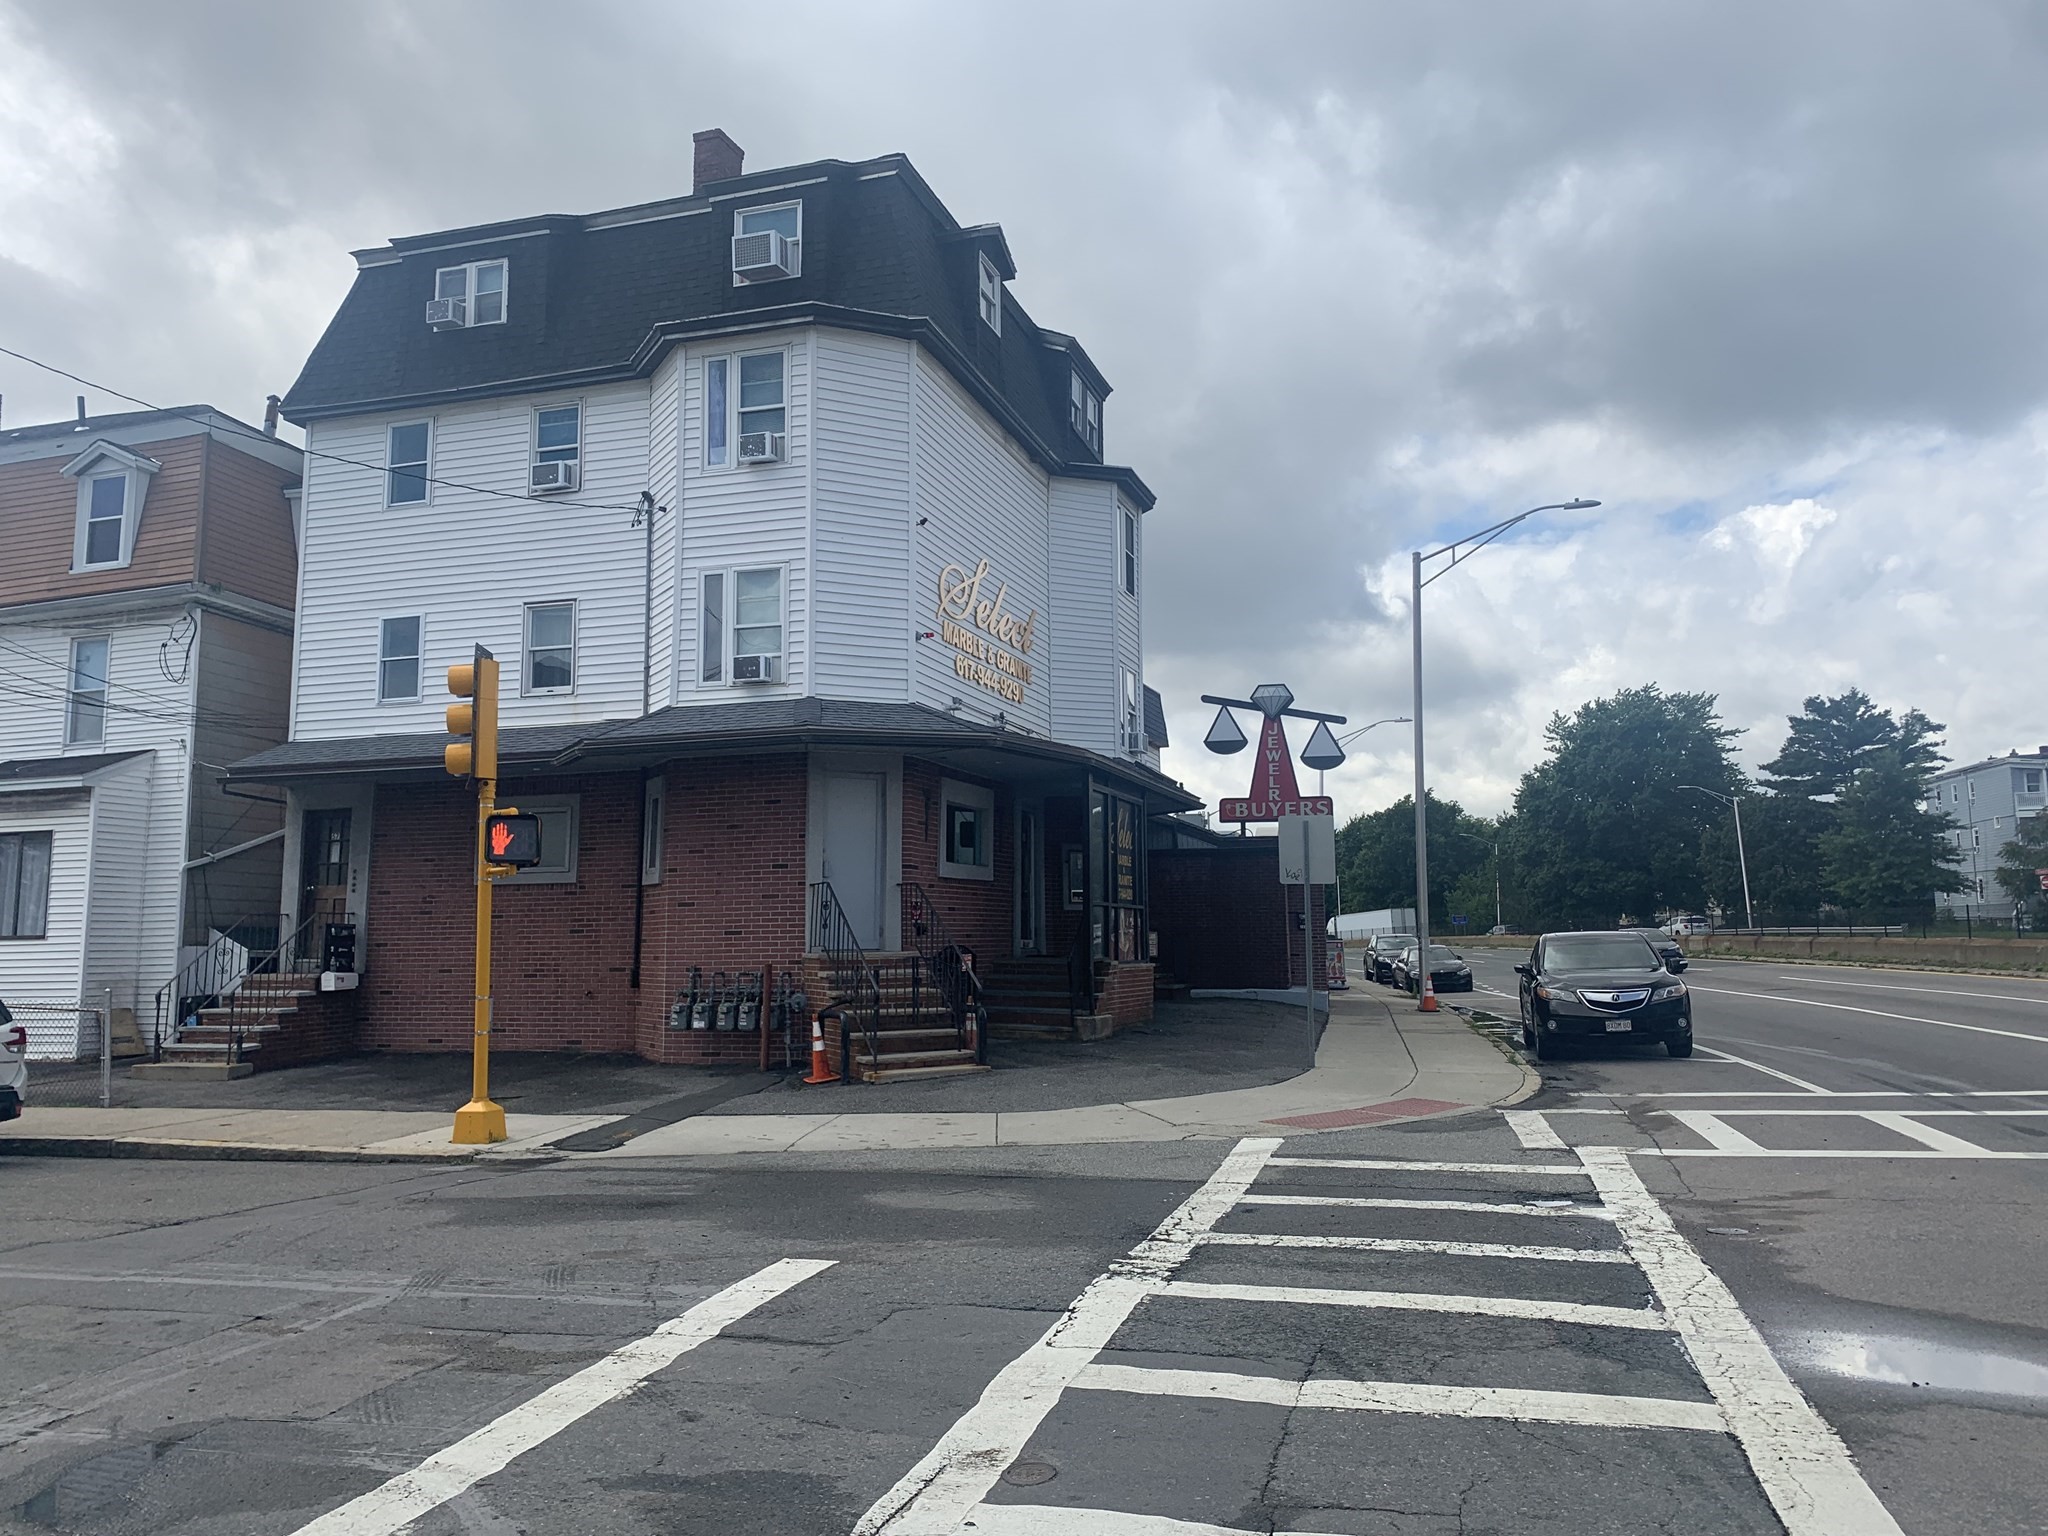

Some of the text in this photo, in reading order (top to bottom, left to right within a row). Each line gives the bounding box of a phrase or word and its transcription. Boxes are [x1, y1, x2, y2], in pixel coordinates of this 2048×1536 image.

[936, 558, 1038, 654] Select
[942, 620, 1033, 686] MARBLE & GRANITE
[1235, 800, 1329, 817] BUYERS
